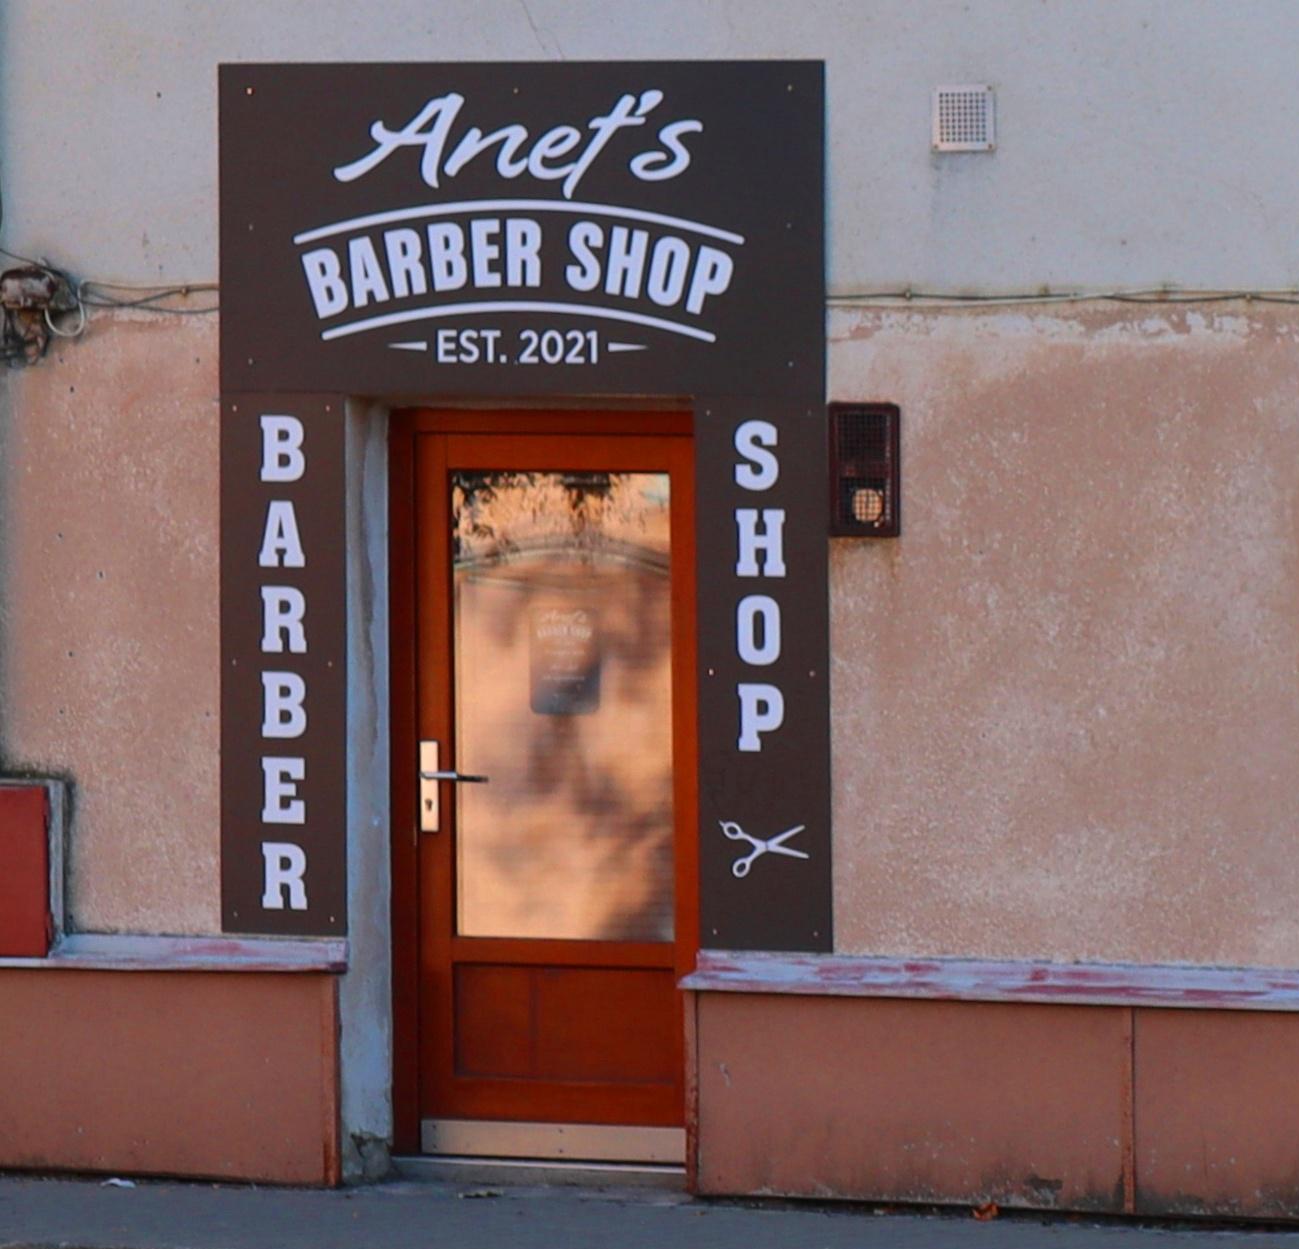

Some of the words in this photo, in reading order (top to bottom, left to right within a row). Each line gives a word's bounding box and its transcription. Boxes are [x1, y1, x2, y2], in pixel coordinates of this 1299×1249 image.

[335, 90, 703, 199] Anet's
[302, 218, 541, 320] BARBER
[567, 222, 734, 314] SHOP
[437, 329, 507, 364] EST.
[519, 329, 598, 364] 2021
[734, 420, 786, 752] SHOP
[259, 415, 307, 910] BARBER
